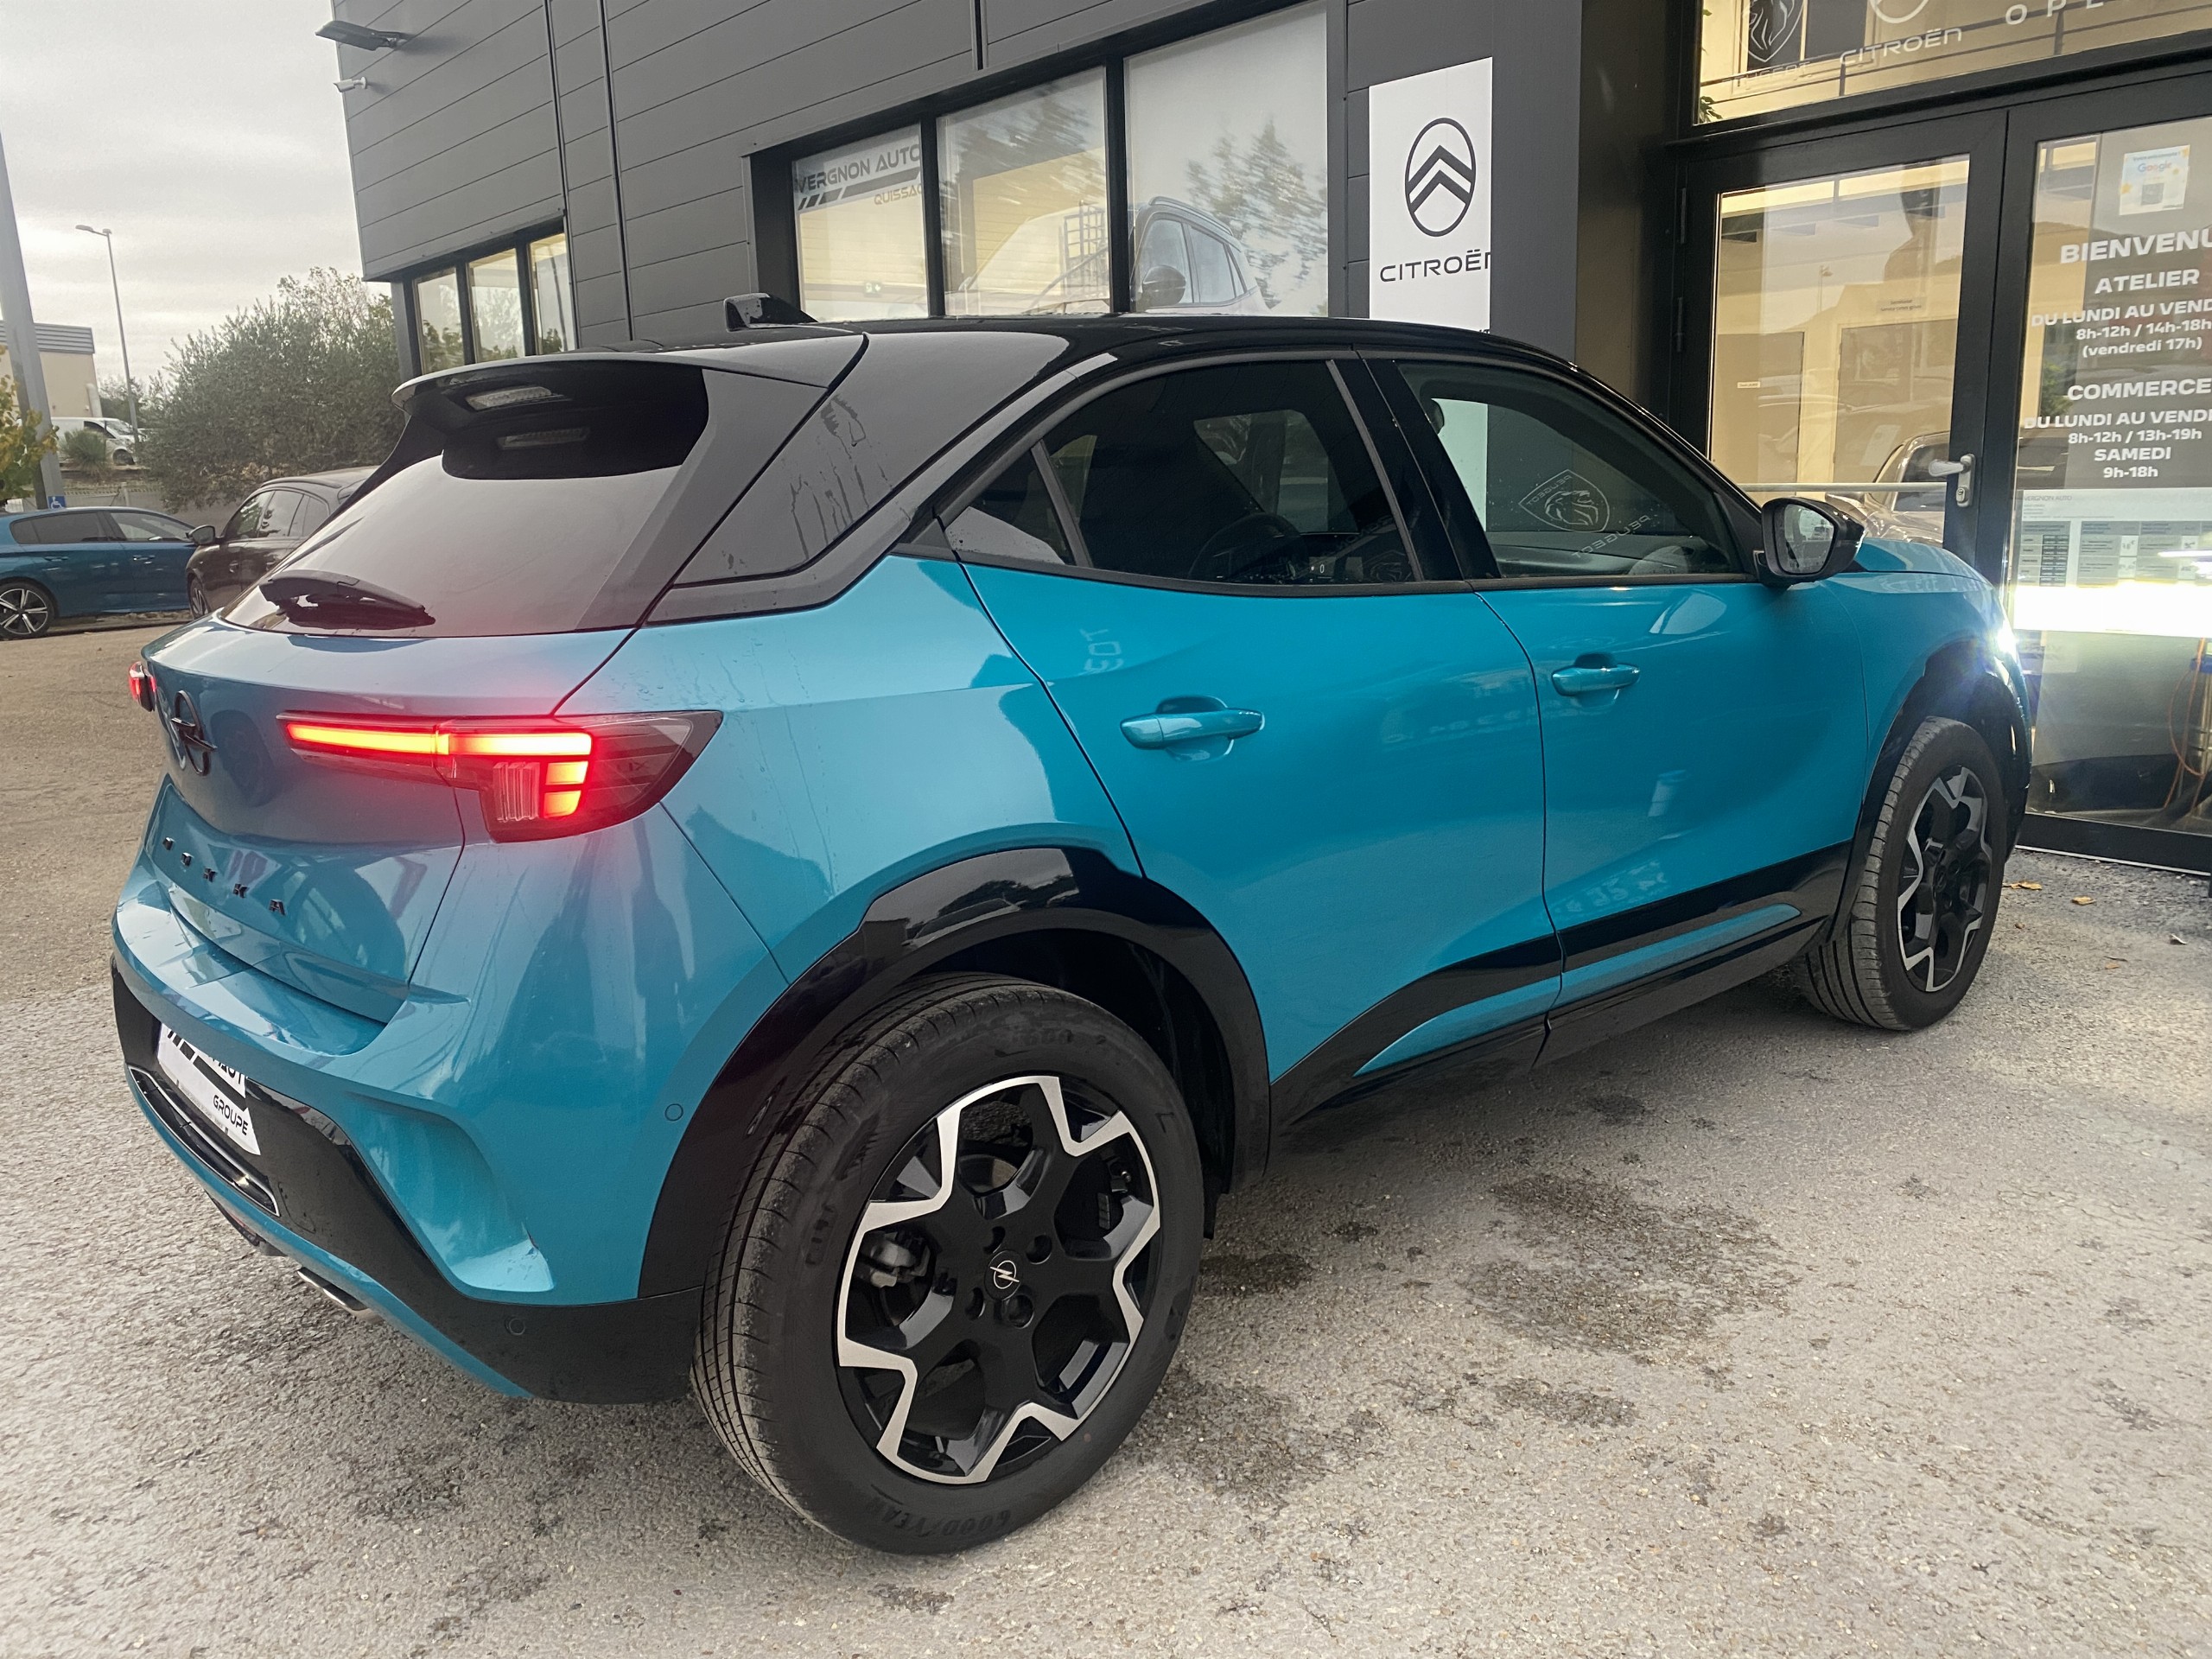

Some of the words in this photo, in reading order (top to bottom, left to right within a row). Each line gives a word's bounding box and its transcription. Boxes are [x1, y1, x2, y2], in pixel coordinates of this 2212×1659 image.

[1840, 28, 1962, 65] CITROËN
[798, 158, 870, 194] VERGNON
[875, 143, 920, 173] AUTO
[2094, 269, 2200, 294] ATELIER
[2031, 313, 2058, 327] DU
[2062, 307, 2120, 325] LUNDI
[2125, 304, 2154, 319] AU
[2075, 326, 2131, 340] 8h-12h
[2146, 319, 2212, 334] 14h-18h
[2082, 340, 2162, 359] (vendredi
[2165, 336, 2202, 351] 17h)
[2067, 378, 2212, 401] COMMERCE
[2024, 416, 2051, 429] DU
[2055, 413, 2112, 428] LUNDI
[2116, 411, 2145, 425] AU
[2150, 409, 2212, 424] VEND
[2068, 431, 2122, 444] 8h-12h
[2137, 429, 2202, 442] 13h-19h
[2094, 447, 2171, 461] SAMEDI
[2103, 466, 2158, 478] 9h-18h
[213, 1094, 249, 1136] GROUPE
